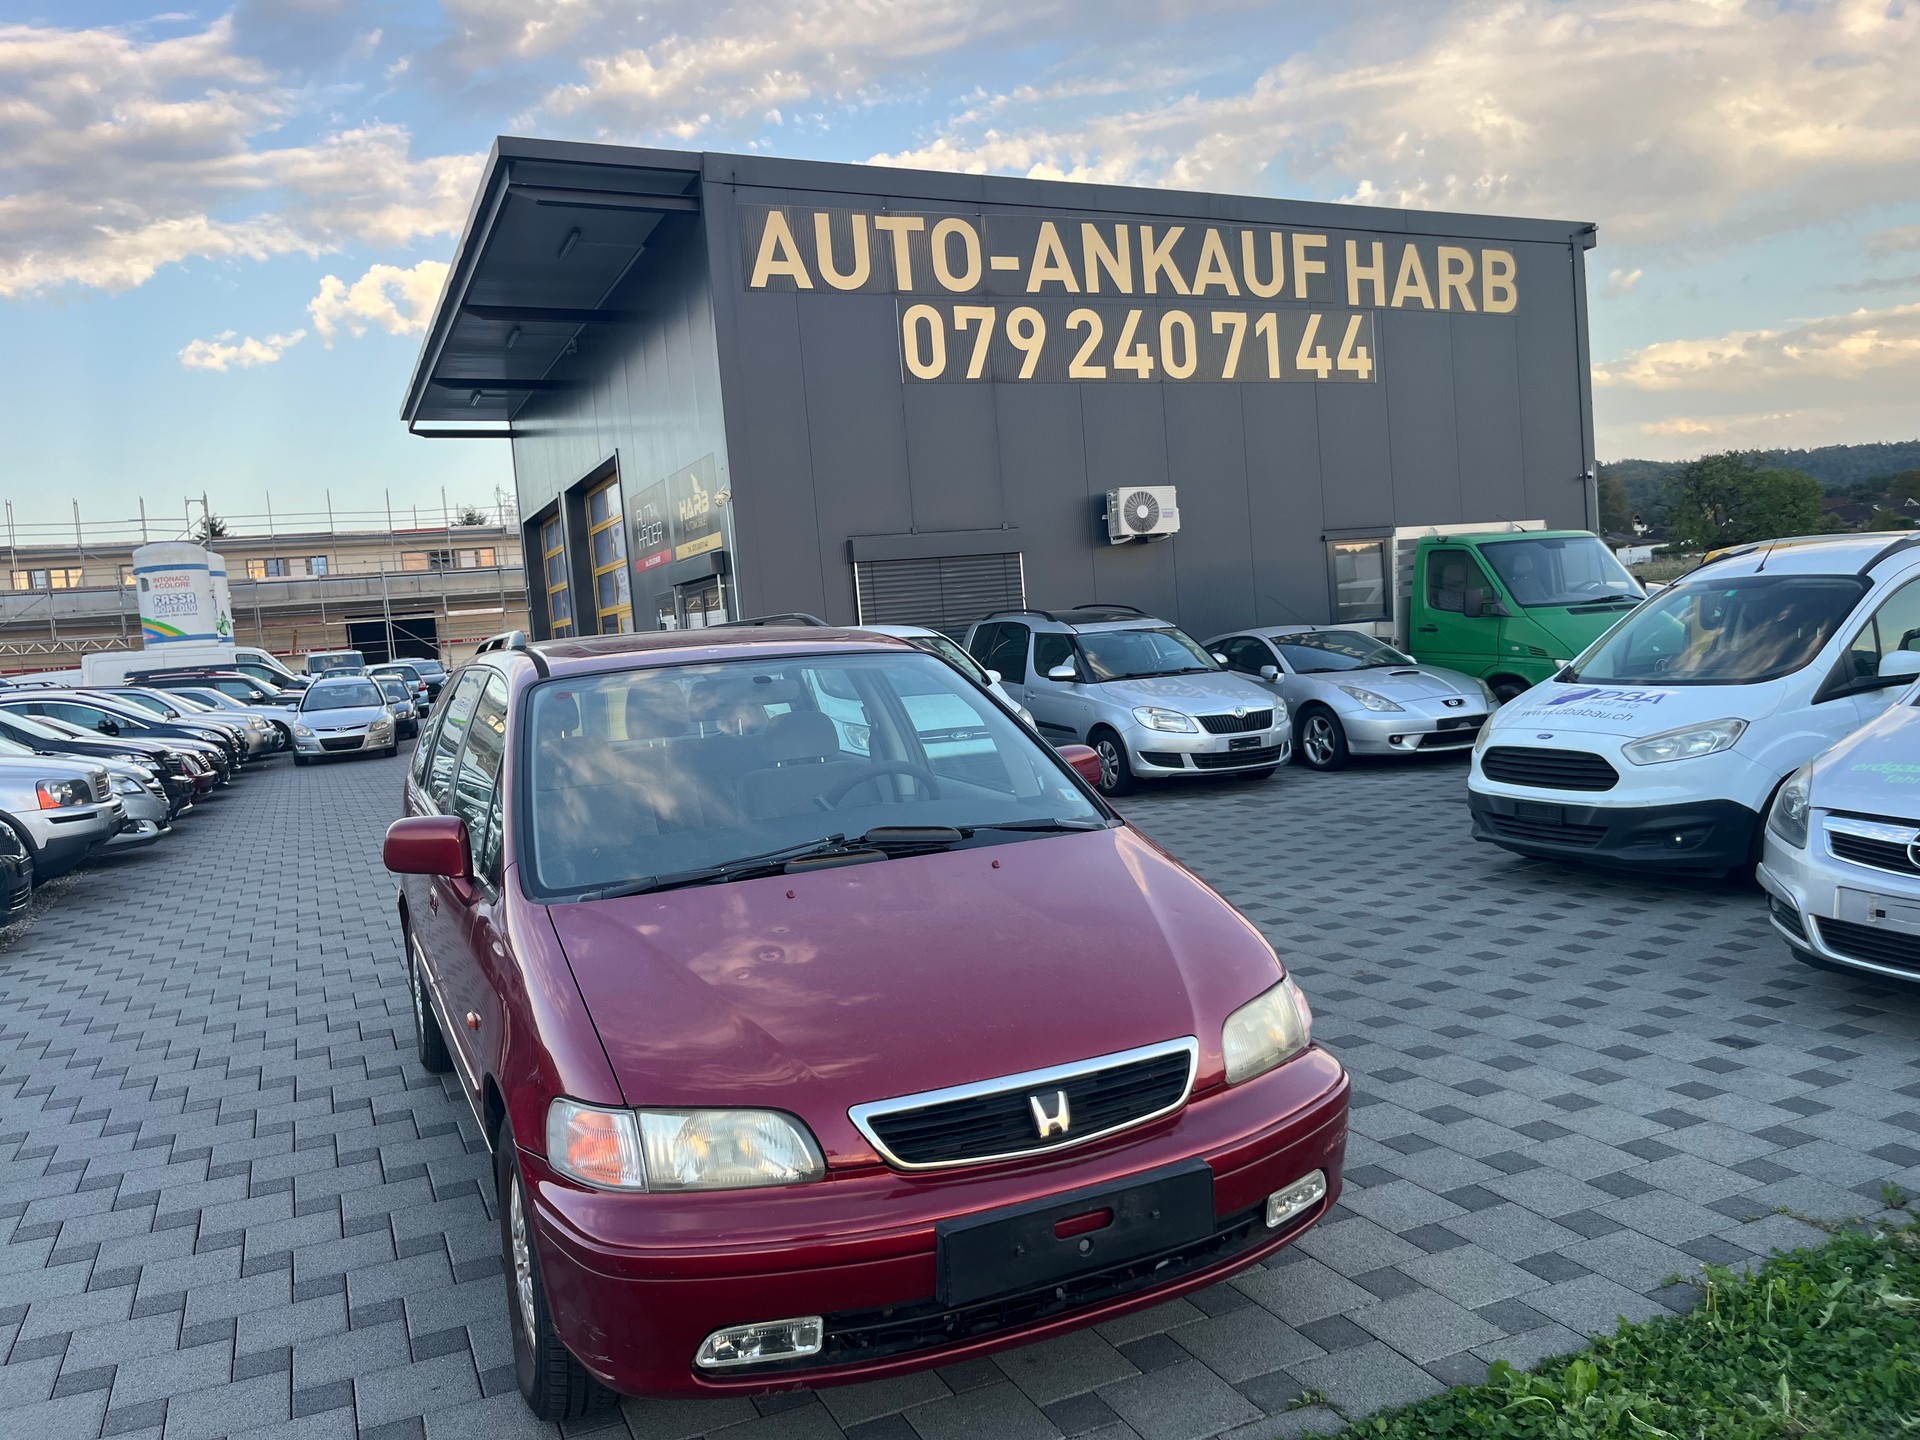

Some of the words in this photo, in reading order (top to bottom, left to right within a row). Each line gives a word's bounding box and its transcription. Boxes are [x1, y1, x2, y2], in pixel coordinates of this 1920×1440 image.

[750, 210, 1328, 299] AUTO-ANKAUF
[1345, 239, 1518, 314] HARB
[678, 489, 710, 522] HARB
[153, 575, 190, 583] INTONACO
[153, 592, 197, 607] FASSA
[1591, 691, 1667, 704] DBA
